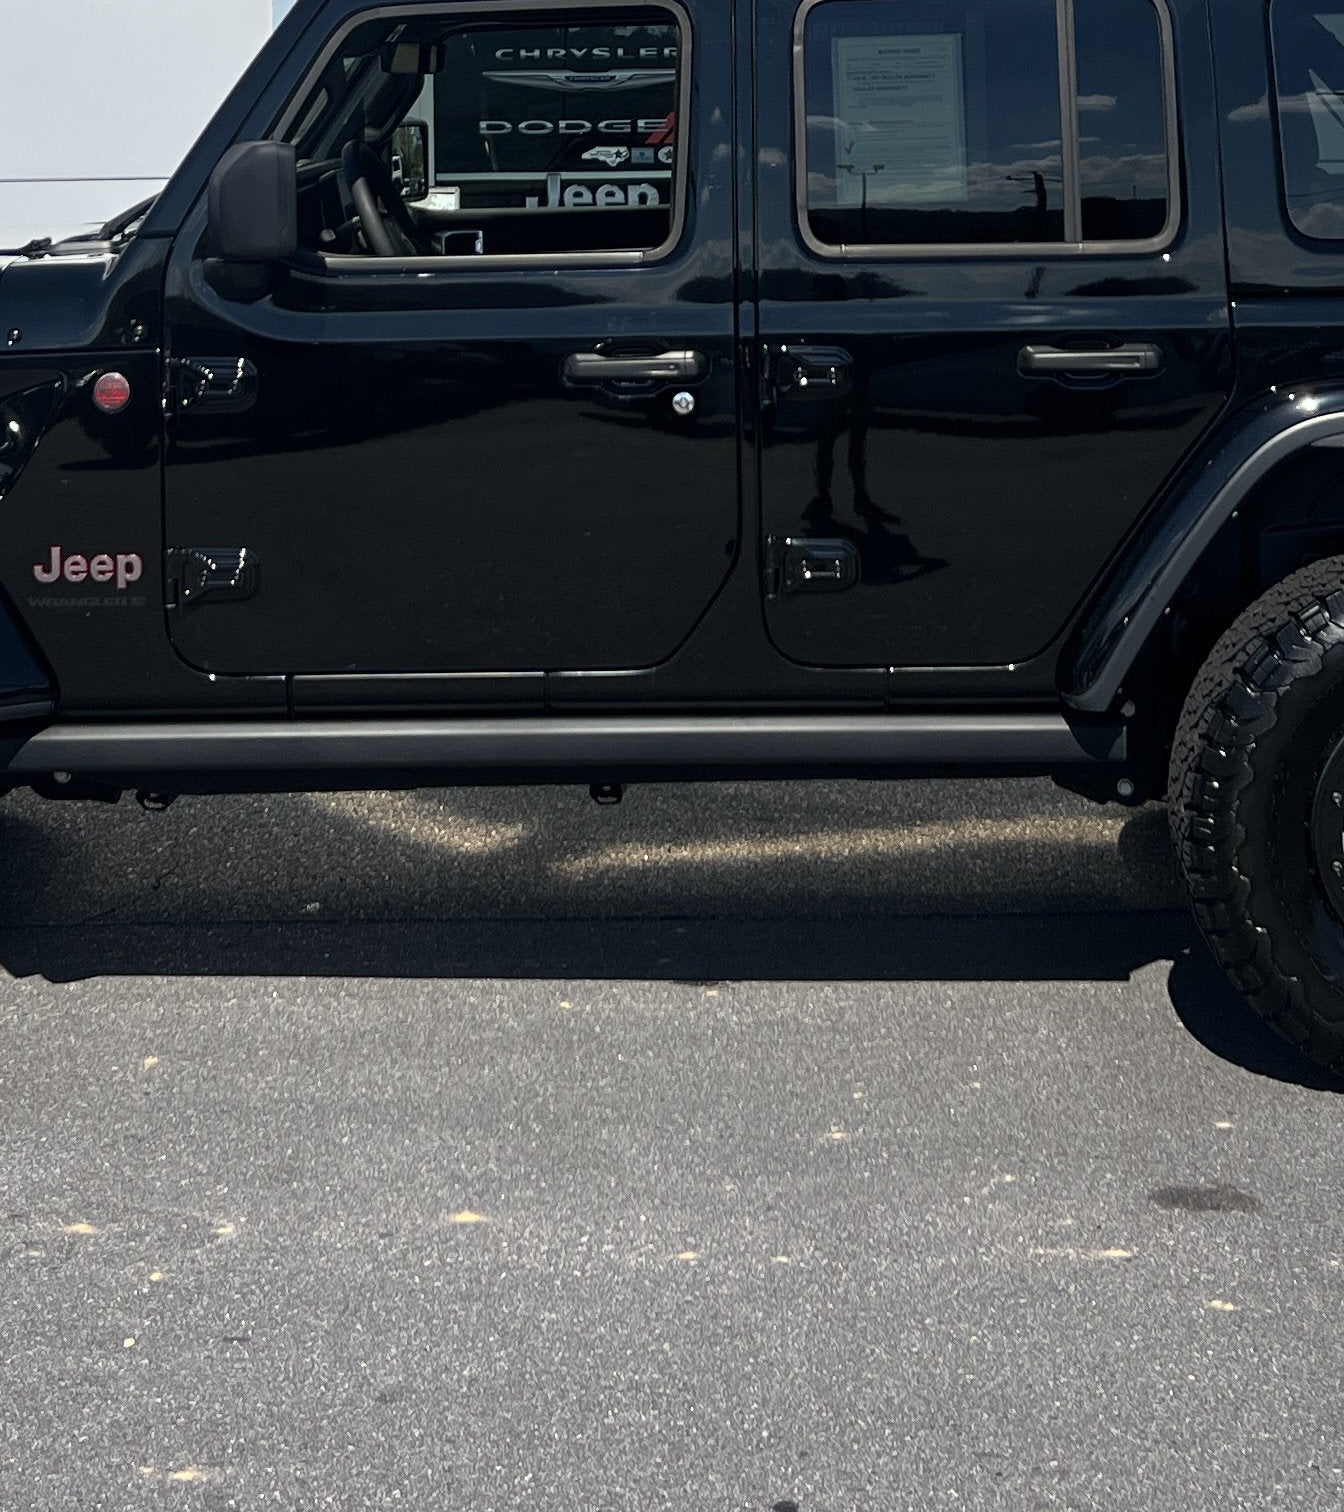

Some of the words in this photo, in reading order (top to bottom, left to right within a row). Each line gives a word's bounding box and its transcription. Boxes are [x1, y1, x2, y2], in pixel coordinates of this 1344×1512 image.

[495, 47, 678, 61] CHRYSLER
[479, 119, 669, 135] DODGE
[33, 545, 143, 589] Jeep
